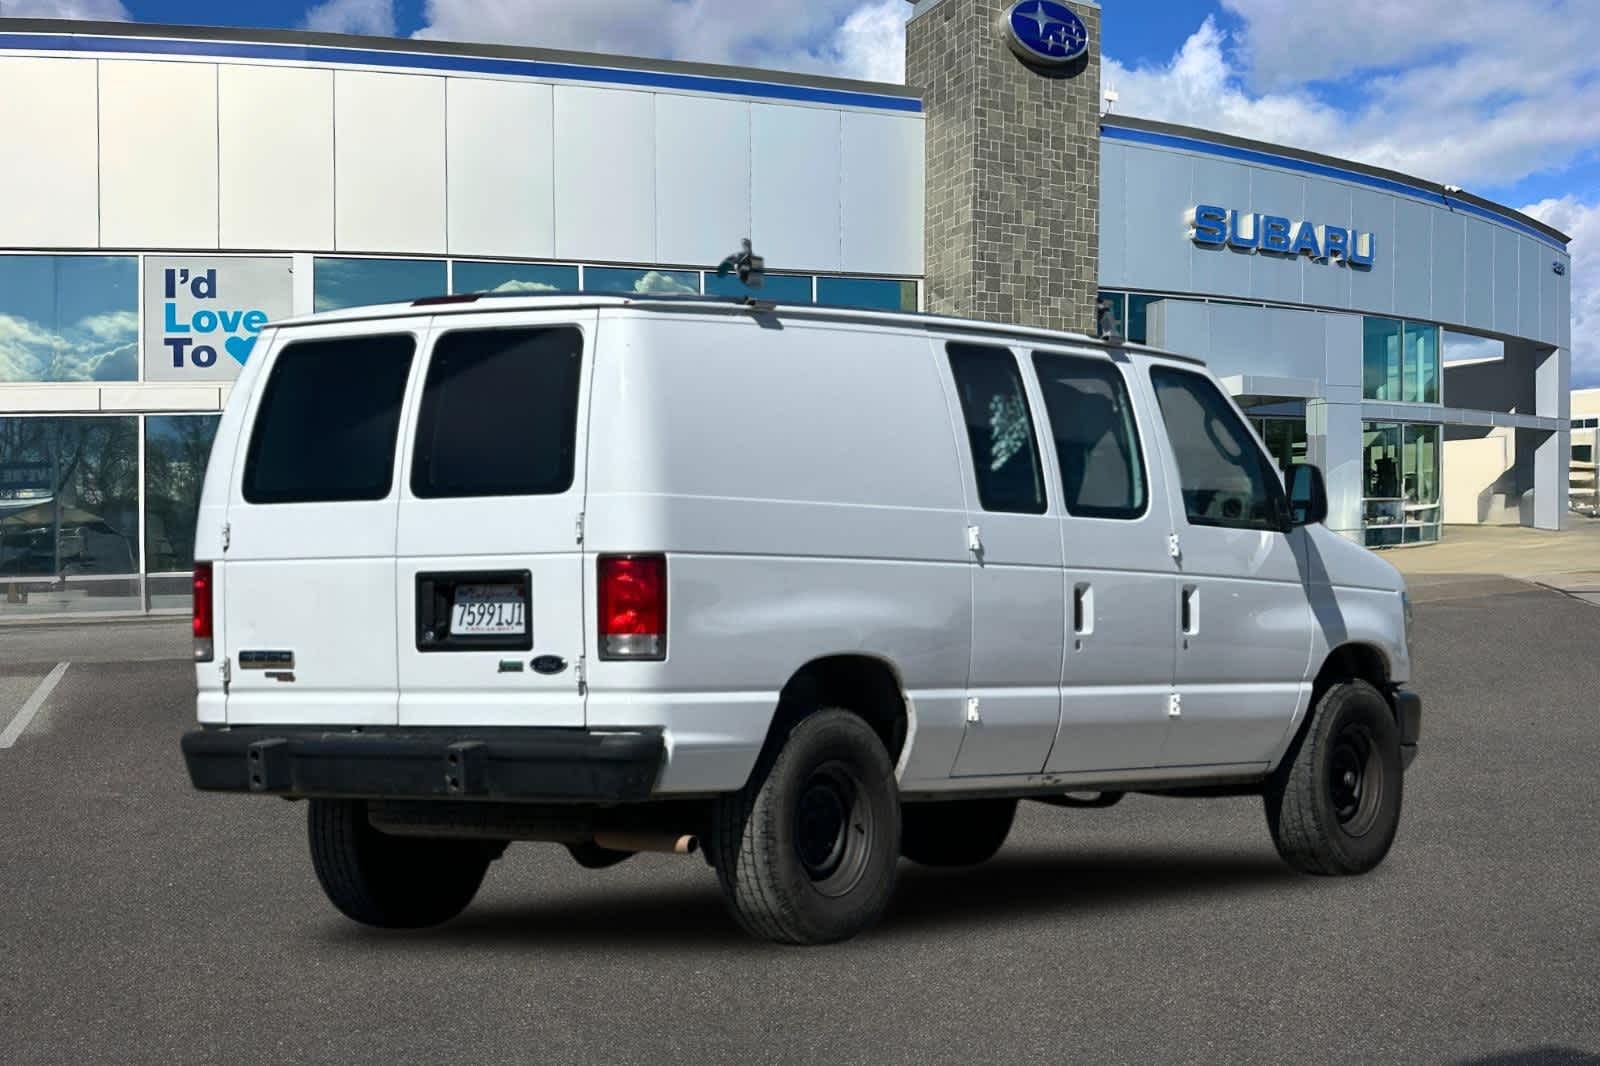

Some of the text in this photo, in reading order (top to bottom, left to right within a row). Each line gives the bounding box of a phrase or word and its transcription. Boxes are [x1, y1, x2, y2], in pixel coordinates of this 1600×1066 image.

[1191, 204, 1376, 271] SUBARU
[165, 268, 217, 299] I'd
[165, 302, 269, 333] Love
[164, 337, 218, 368] To
[458, 602, 523, 627] 75991J1
